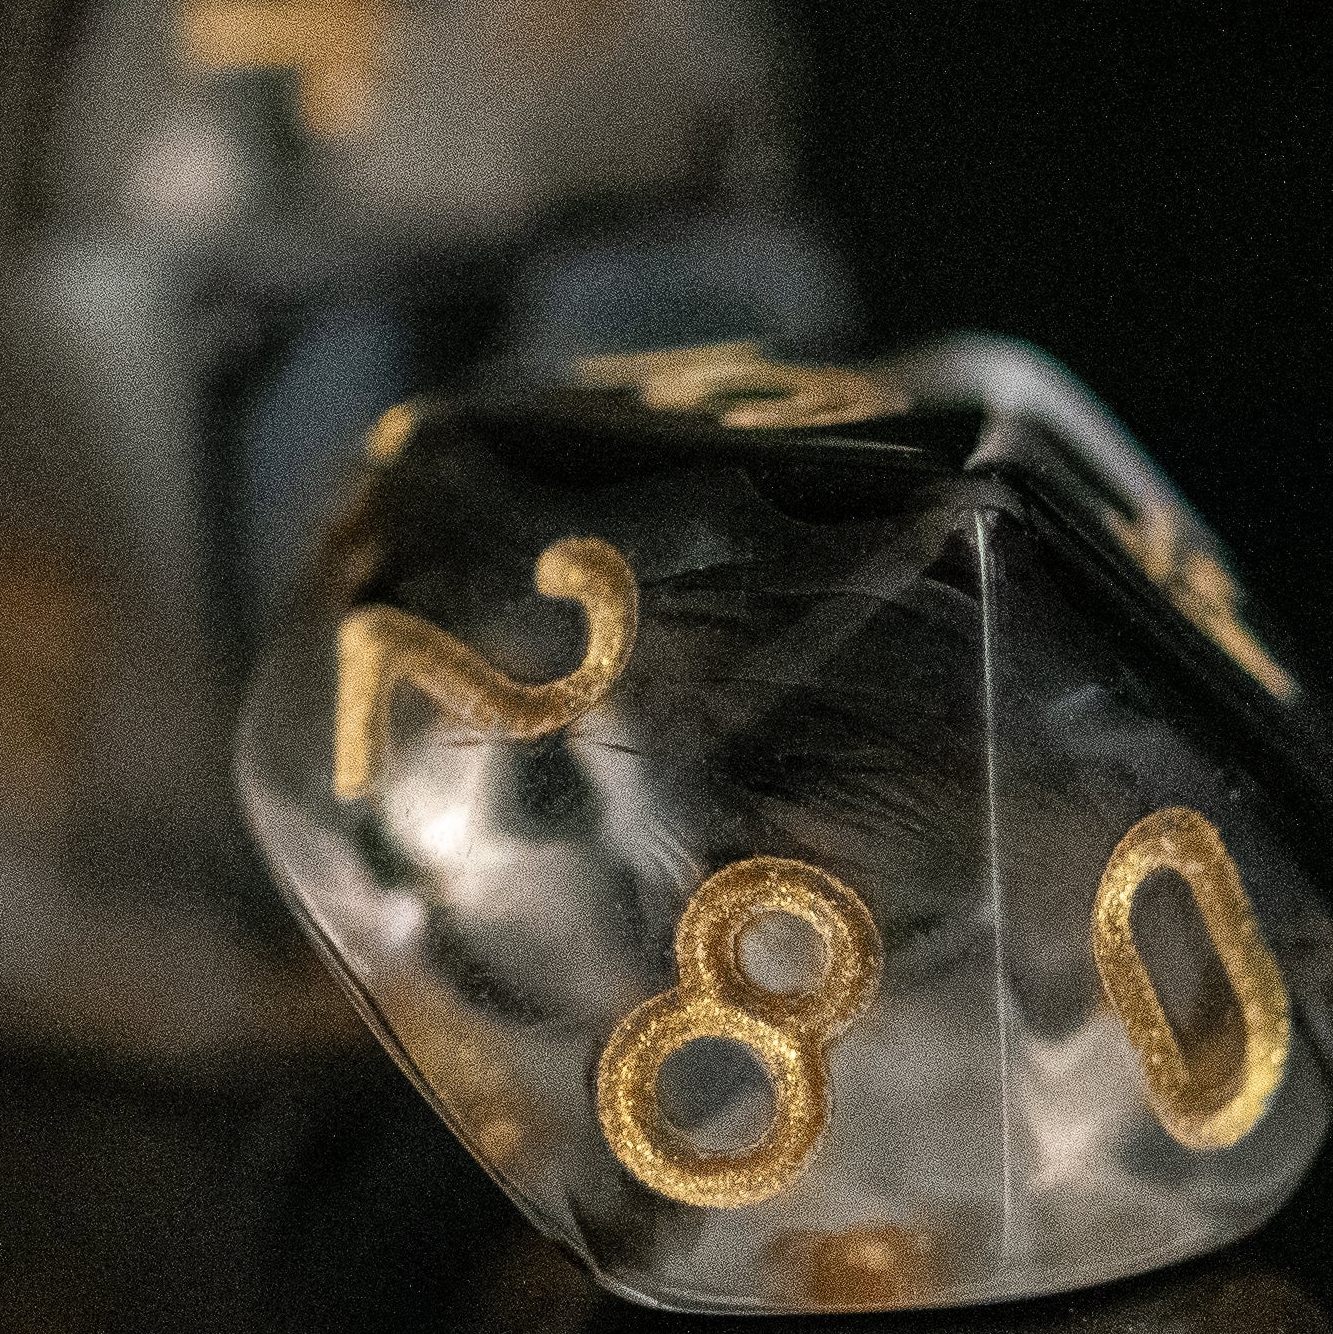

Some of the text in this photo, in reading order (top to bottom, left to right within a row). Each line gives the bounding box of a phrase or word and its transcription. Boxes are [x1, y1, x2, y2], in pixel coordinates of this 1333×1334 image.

[333, 537, 638, 800] 2
[597, 855, 883, 1208] 8
[1091, 807, 1291, 1149] 0
